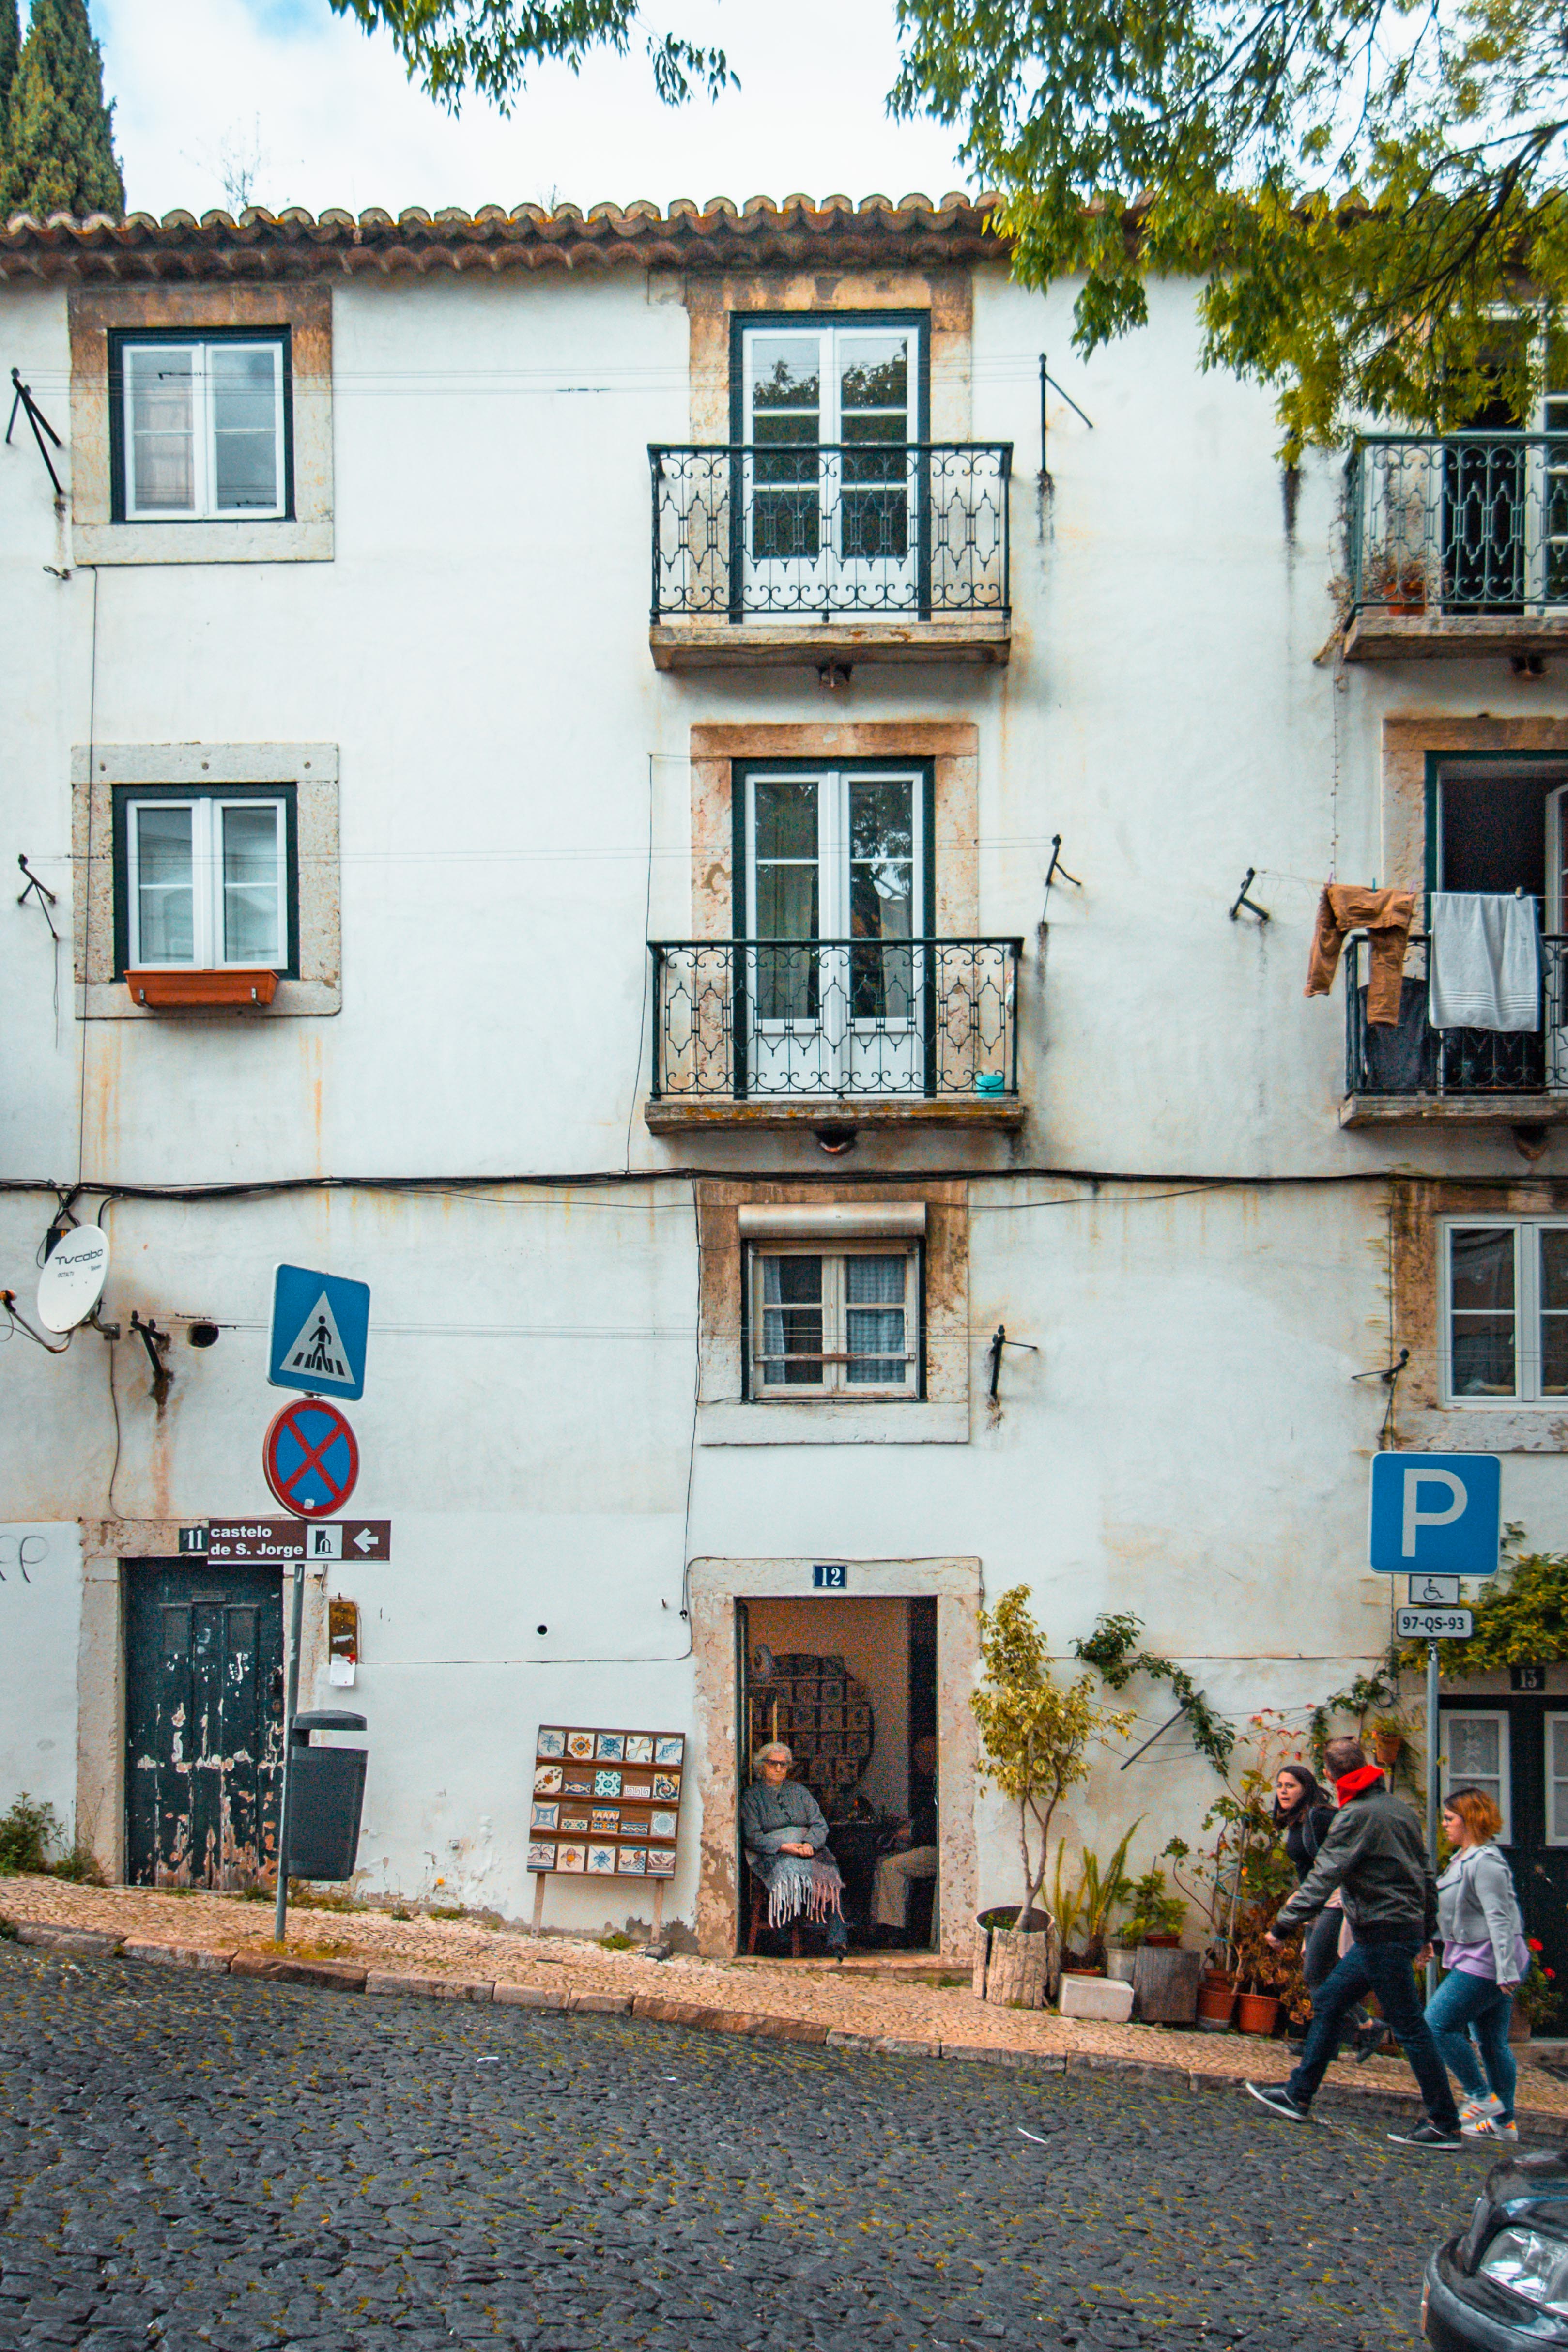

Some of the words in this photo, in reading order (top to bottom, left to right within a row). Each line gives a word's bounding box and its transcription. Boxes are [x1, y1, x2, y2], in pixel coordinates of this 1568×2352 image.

[1402, 1468, 1468, 1557] P
[188, 1530, 203, 1549] 11
[210, 1525, 272, 1537] castelo
[210, 1543, 231, 1555] de
[235, 1543, 251, 1555] S.
[256, 1543, 304, 1558] Jorge
[822, 1568, 841, 1586] 12
[1402, 1616, 1464, 1633] 97-QS-93
